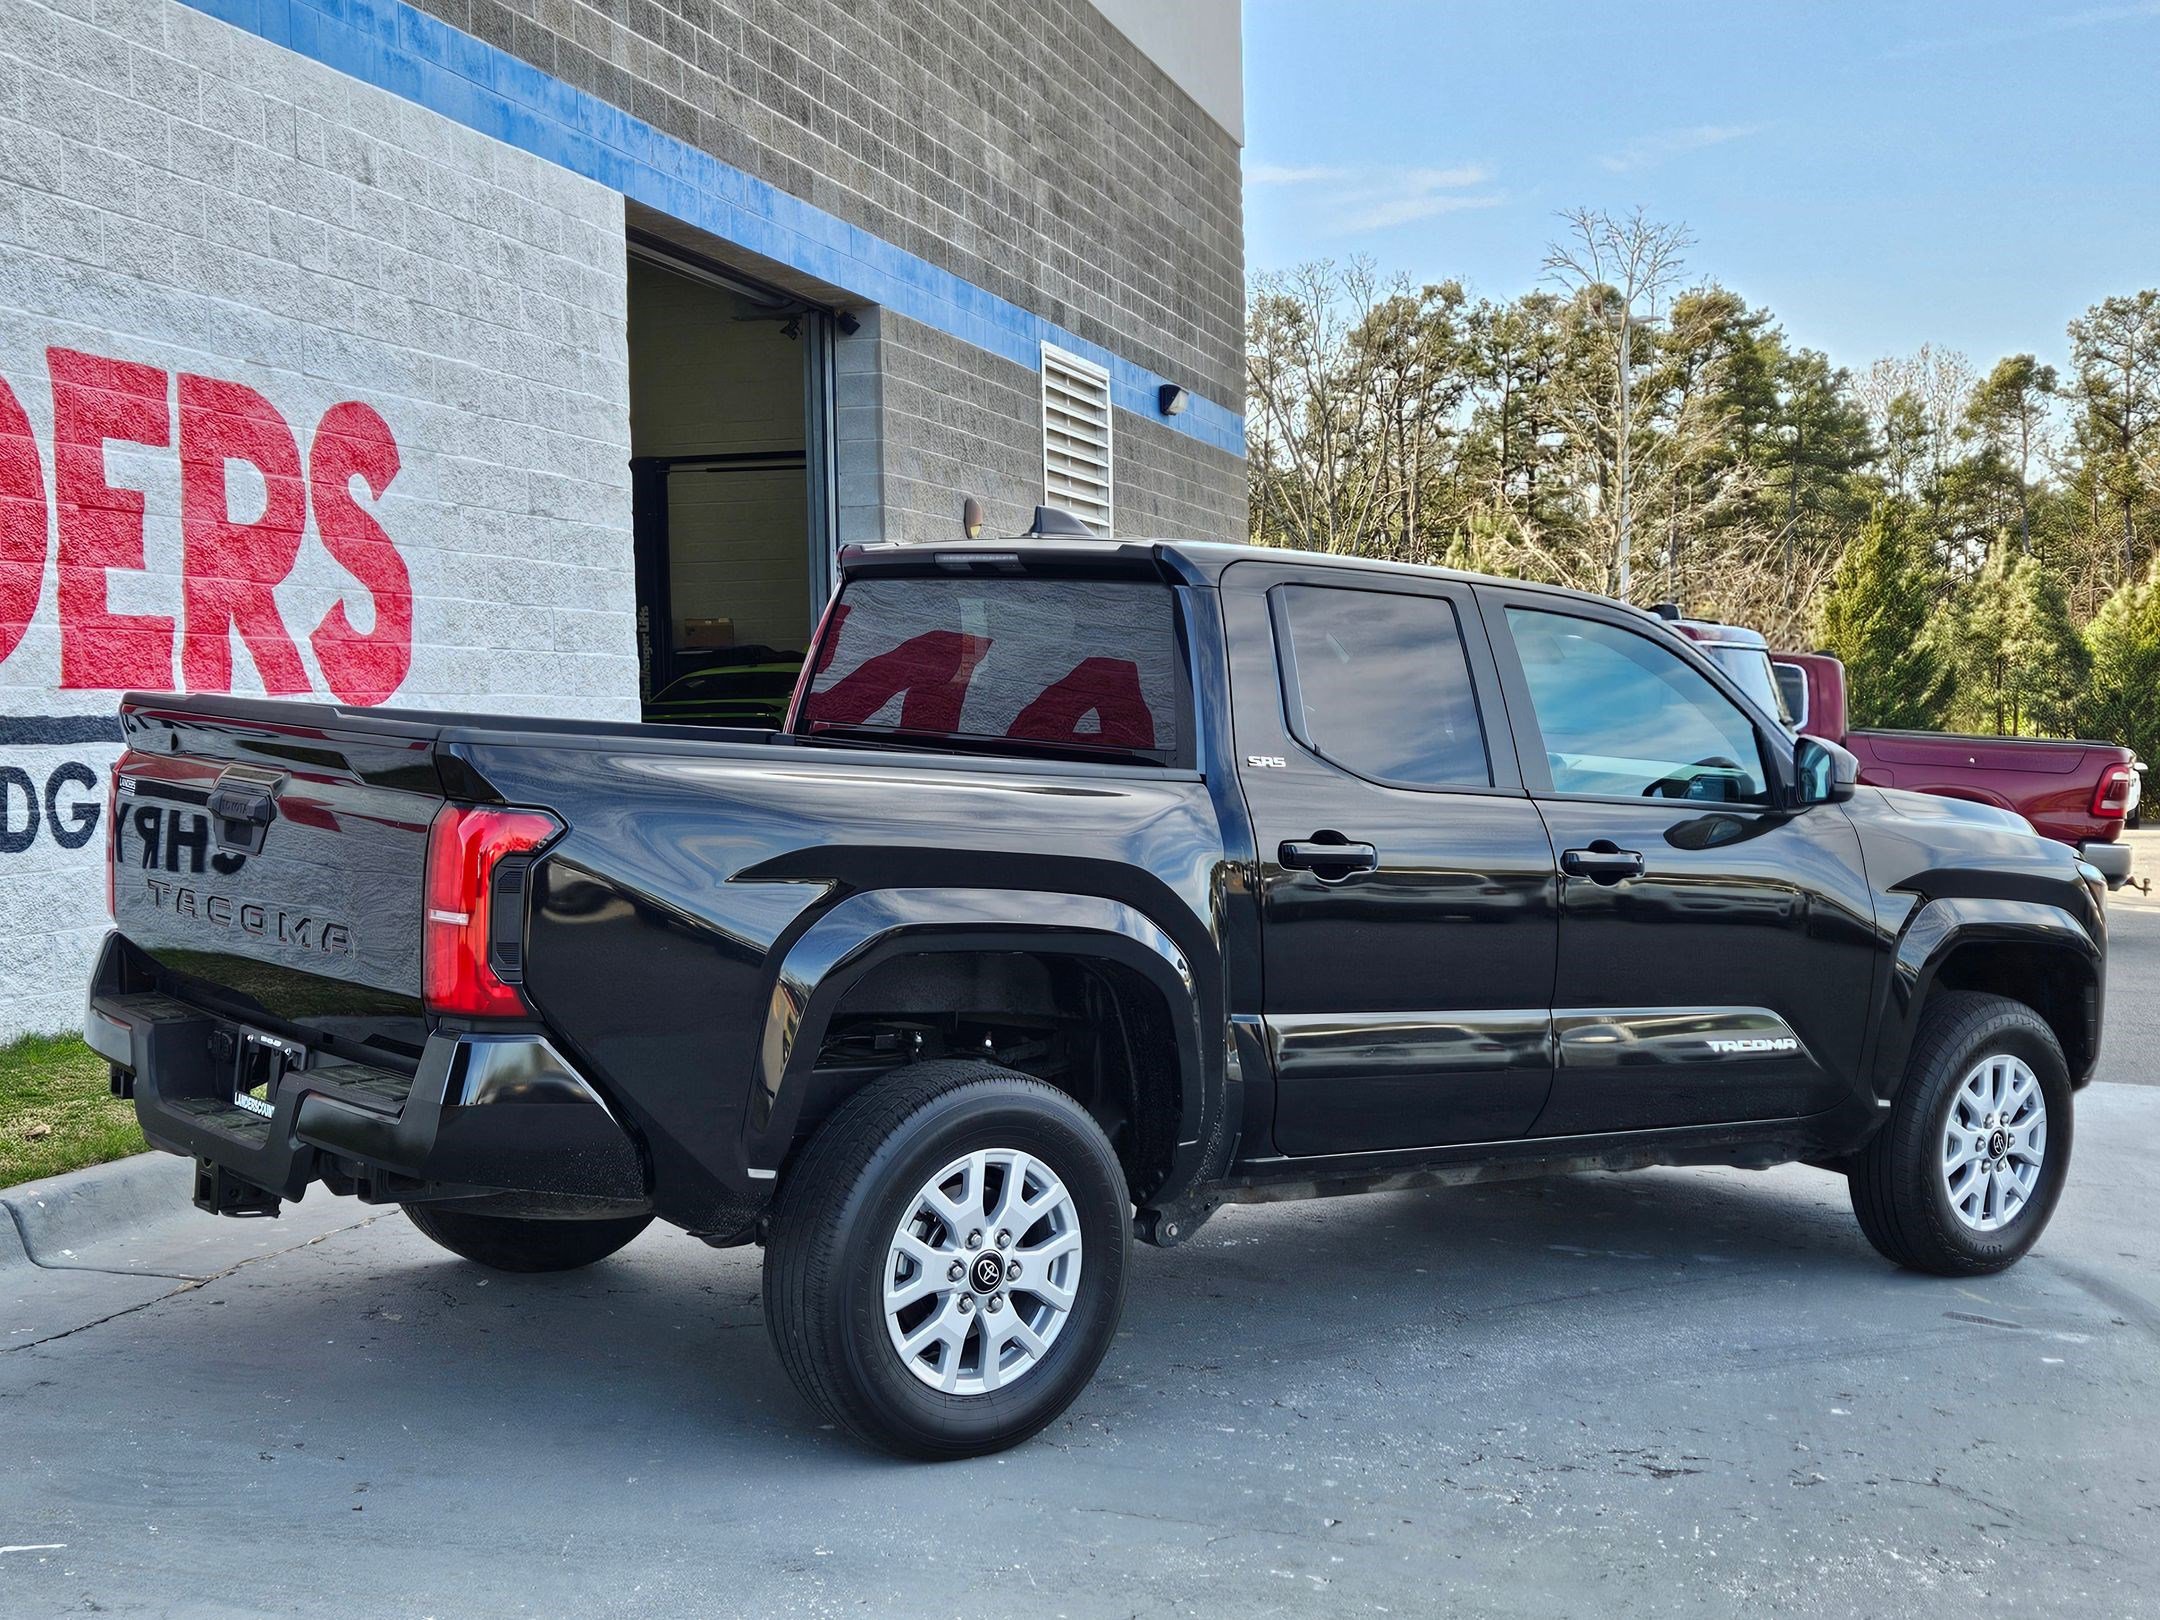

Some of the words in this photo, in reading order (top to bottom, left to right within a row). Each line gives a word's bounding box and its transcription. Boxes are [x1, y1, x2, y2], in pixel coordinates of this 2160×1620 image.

[639, 605, 650, 632] Lifts
[148, 879, 355, 959] TACOMA
[1706, 1038, 1798, 1053] TACOMA
